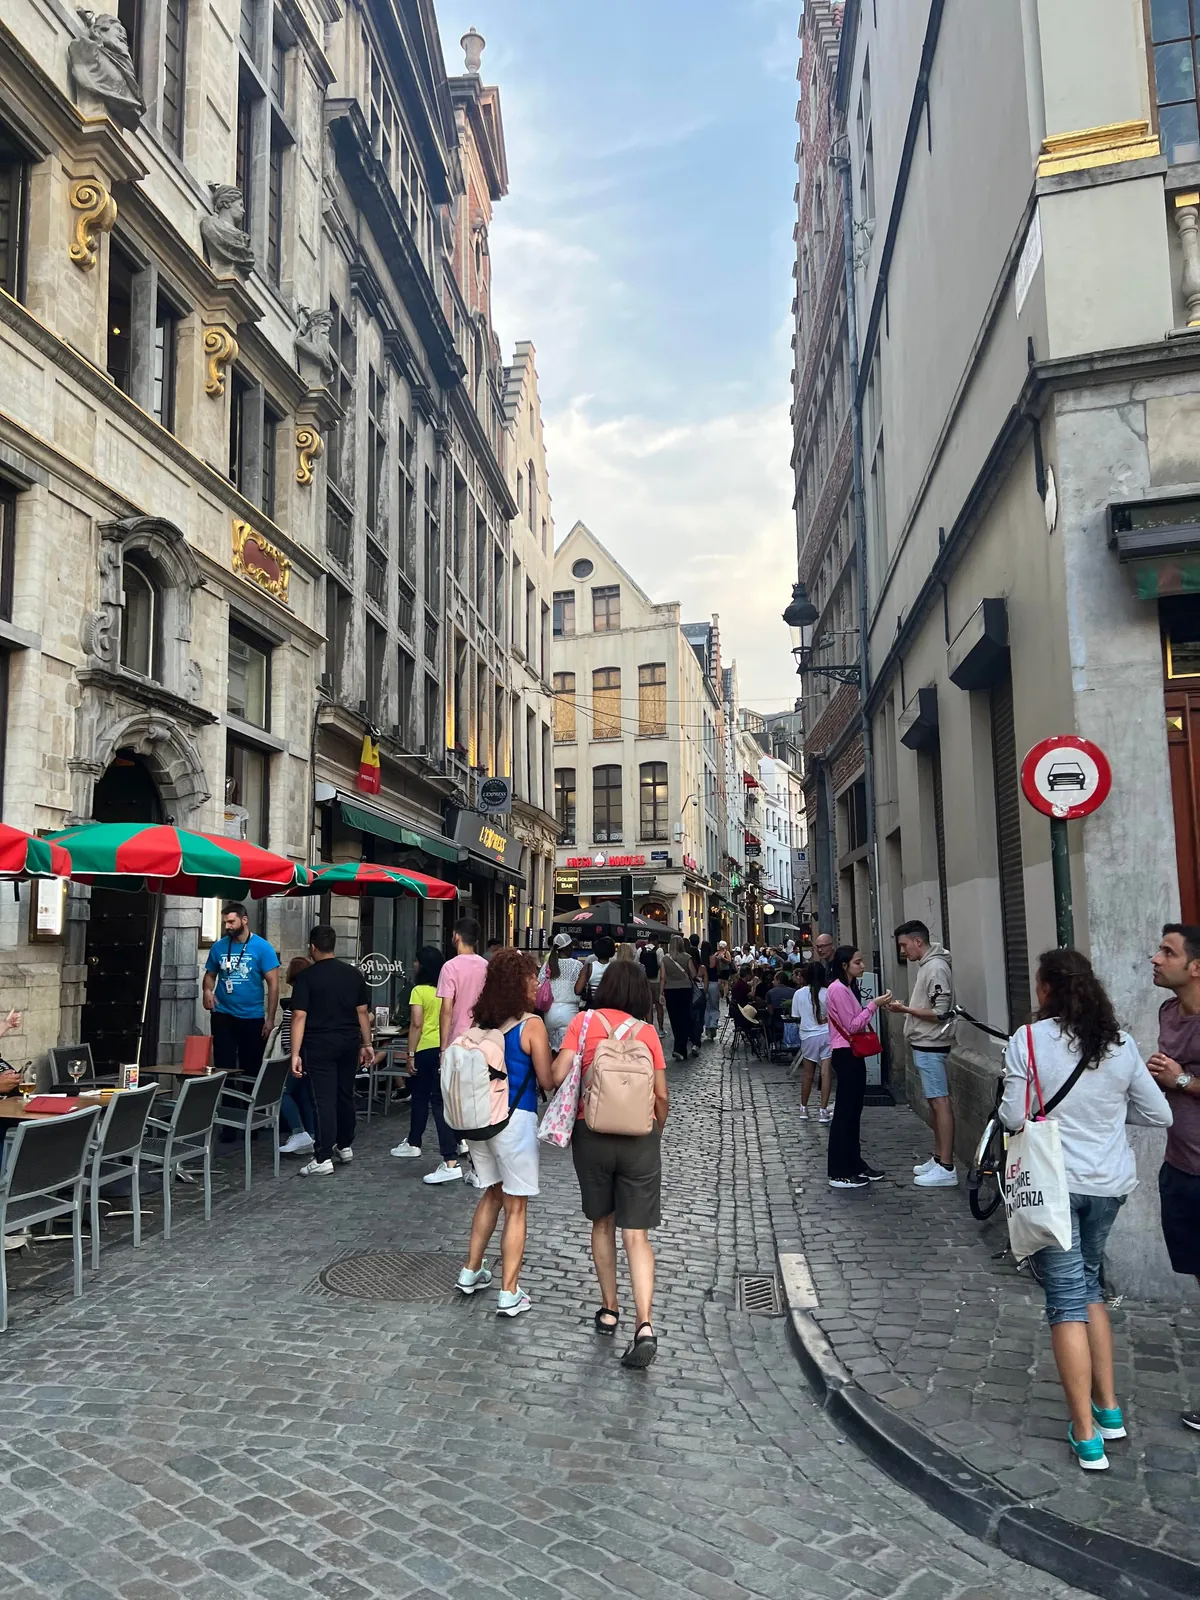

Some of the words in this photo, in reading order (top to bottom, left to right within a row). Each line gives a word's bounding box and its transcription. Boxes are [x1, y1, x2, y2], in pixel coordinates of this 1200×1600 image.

[479, 826, 506, 853] L'EXPRESS
[566, 857, 593, 868] FRESH
[608, 855, 645, 867] NOODLES
